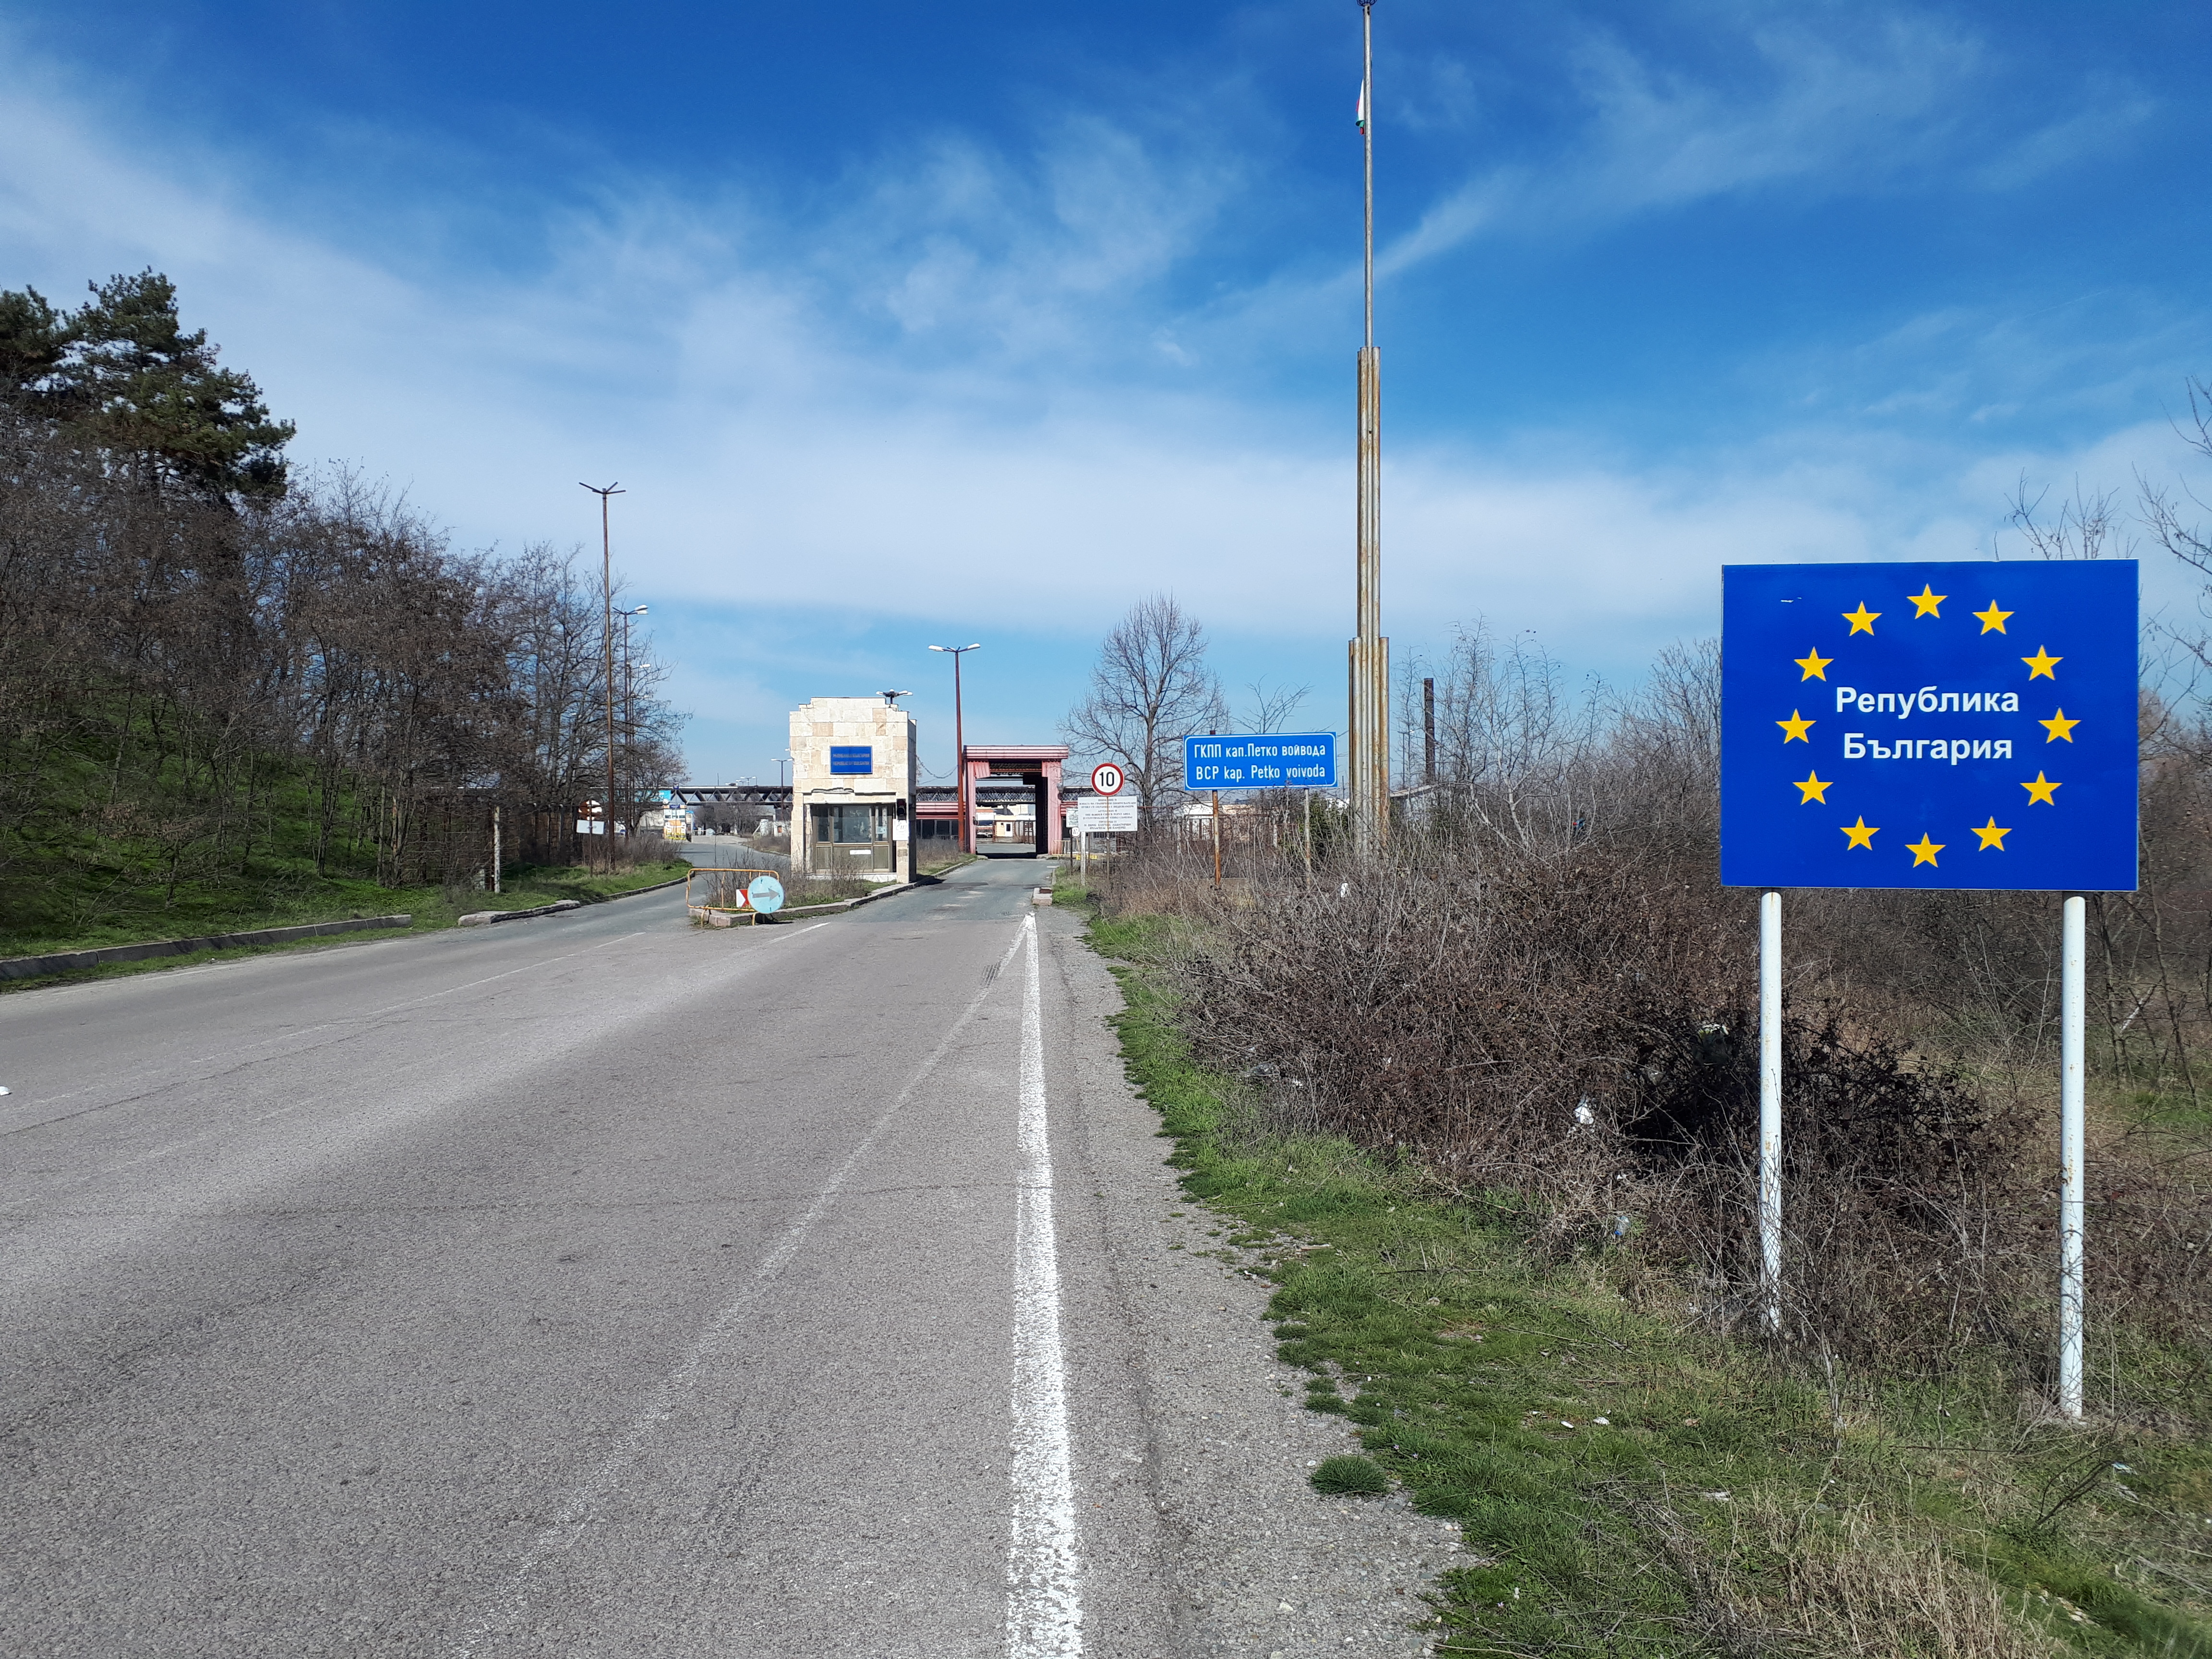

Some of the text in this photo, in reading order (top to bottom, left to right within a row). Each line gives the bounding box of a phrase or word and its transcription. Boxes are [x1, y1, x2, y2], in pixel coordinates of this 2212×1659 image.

[1837, 685, 2019, 719] Република
[1194, 744, 1221, 758] ГКПП
[1282, 744, 1325, 757] войвода
[1844, 733, 2012, 766] България
[1099, 771, 1115, 787] 10
[1196, 764, 1325, 782] BCP kap. Petko voivoda
